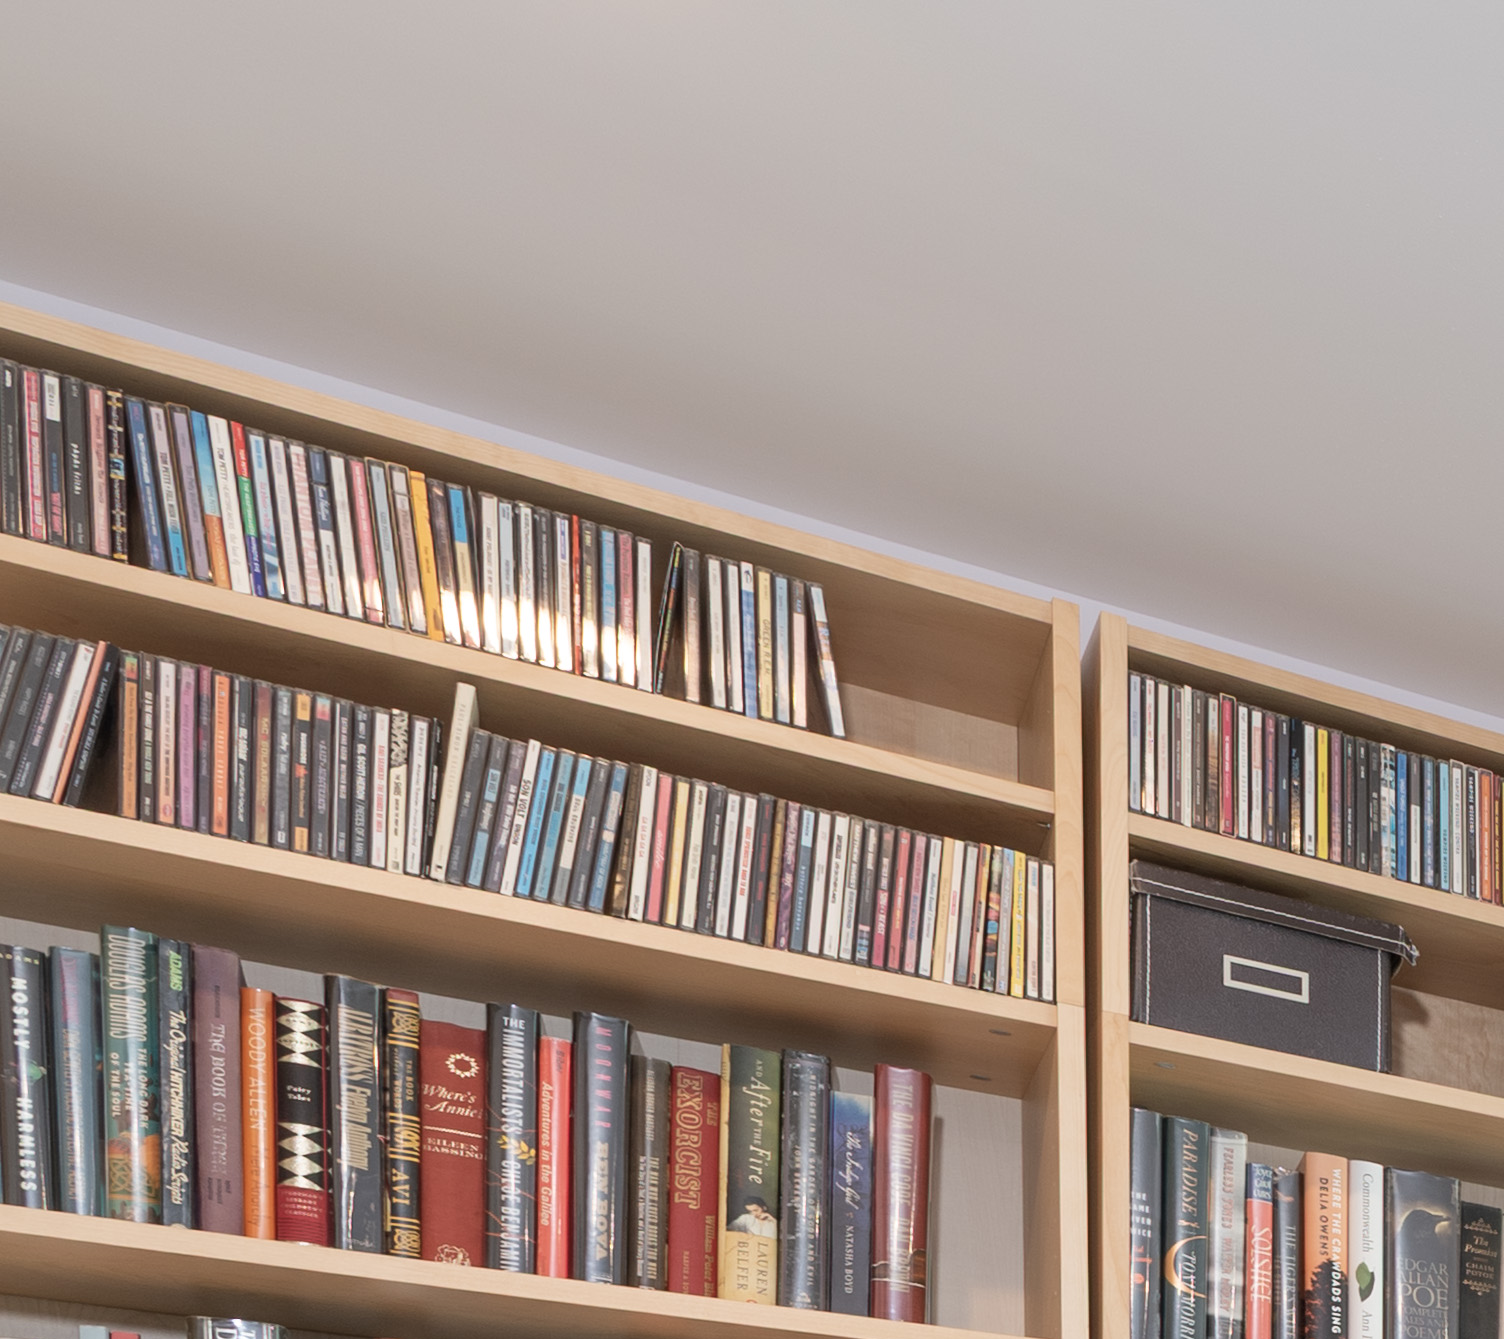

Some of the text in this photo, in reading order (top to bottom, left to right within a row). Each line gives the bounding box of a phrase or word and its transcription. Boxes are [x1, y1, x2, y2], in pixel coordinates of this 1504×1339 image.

[513, 779, 531, 845] SON VOLT UNION
[503, 1017, 525, 1029] THE
[11, 977, 38, 1191] MOSTLY HARMLESS
[501, 1030, 524, 1134] IMMORTALISTS
[743, 1076, 772, 1125] After
[674, 1072, 702, 1210] EXORCIST
[707, 1103, 716, 1127] THE
[748, 1145, 772, 1184] Fire
[1319, 1177, 1329, 1256] DELIA OWENS
[736, 1241, 748, 1291] BELFER
[756, 1242, 768, 1297] LAUREN
[1331, 1169, 1342, 1334] WHERE THE CRAWDADS SING
